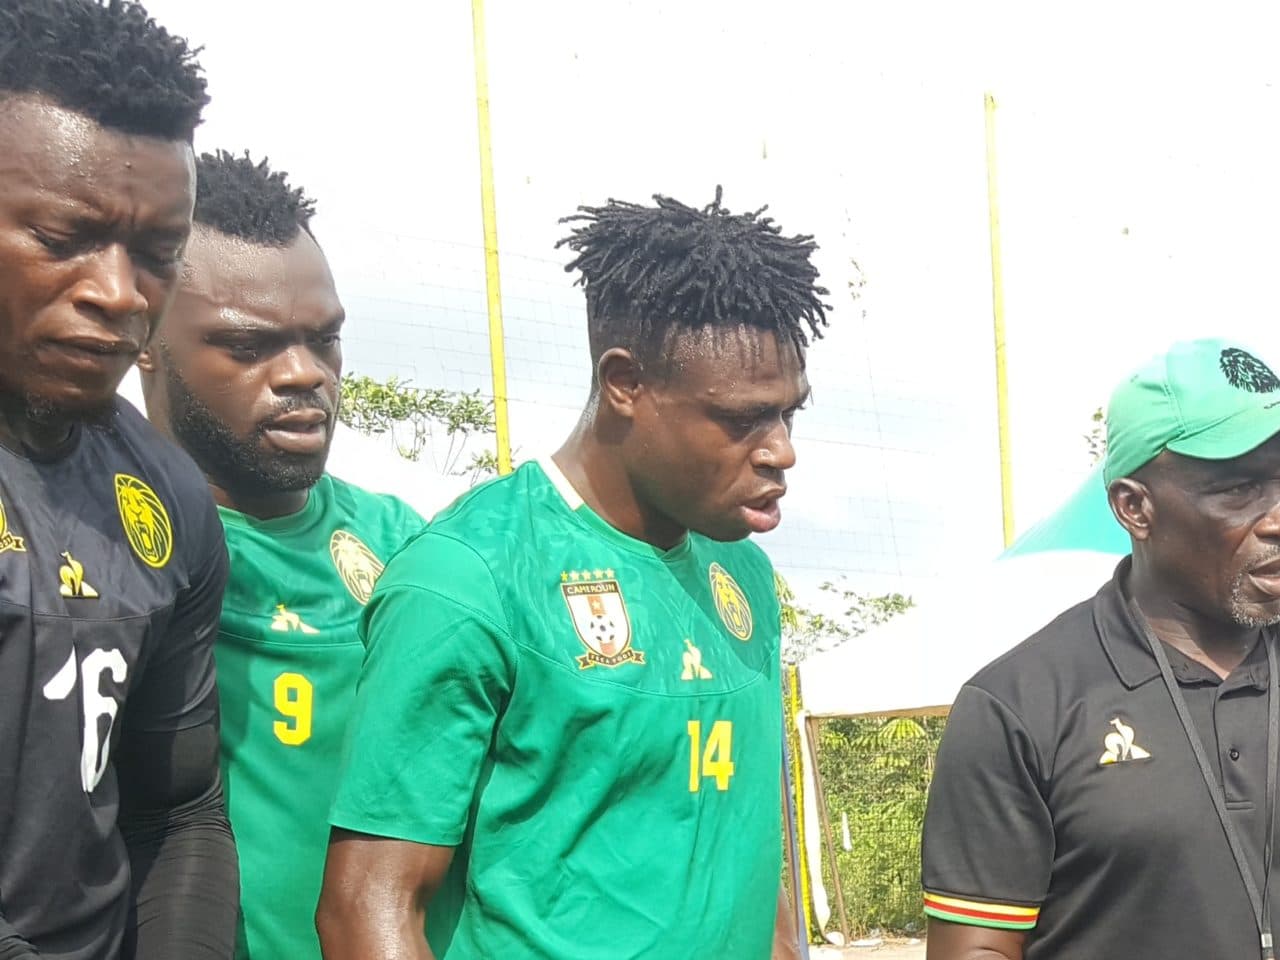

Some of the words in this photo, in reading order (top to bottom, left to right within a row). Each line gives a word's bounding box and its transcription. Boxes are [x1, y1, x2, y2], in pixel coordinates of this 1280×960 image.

[566, 583, 616, 594] CAMEROUN
[43, 646, 128, 793] 16
[274, 673, 313, 746] 9
[688, 721, 734, 791] 14
